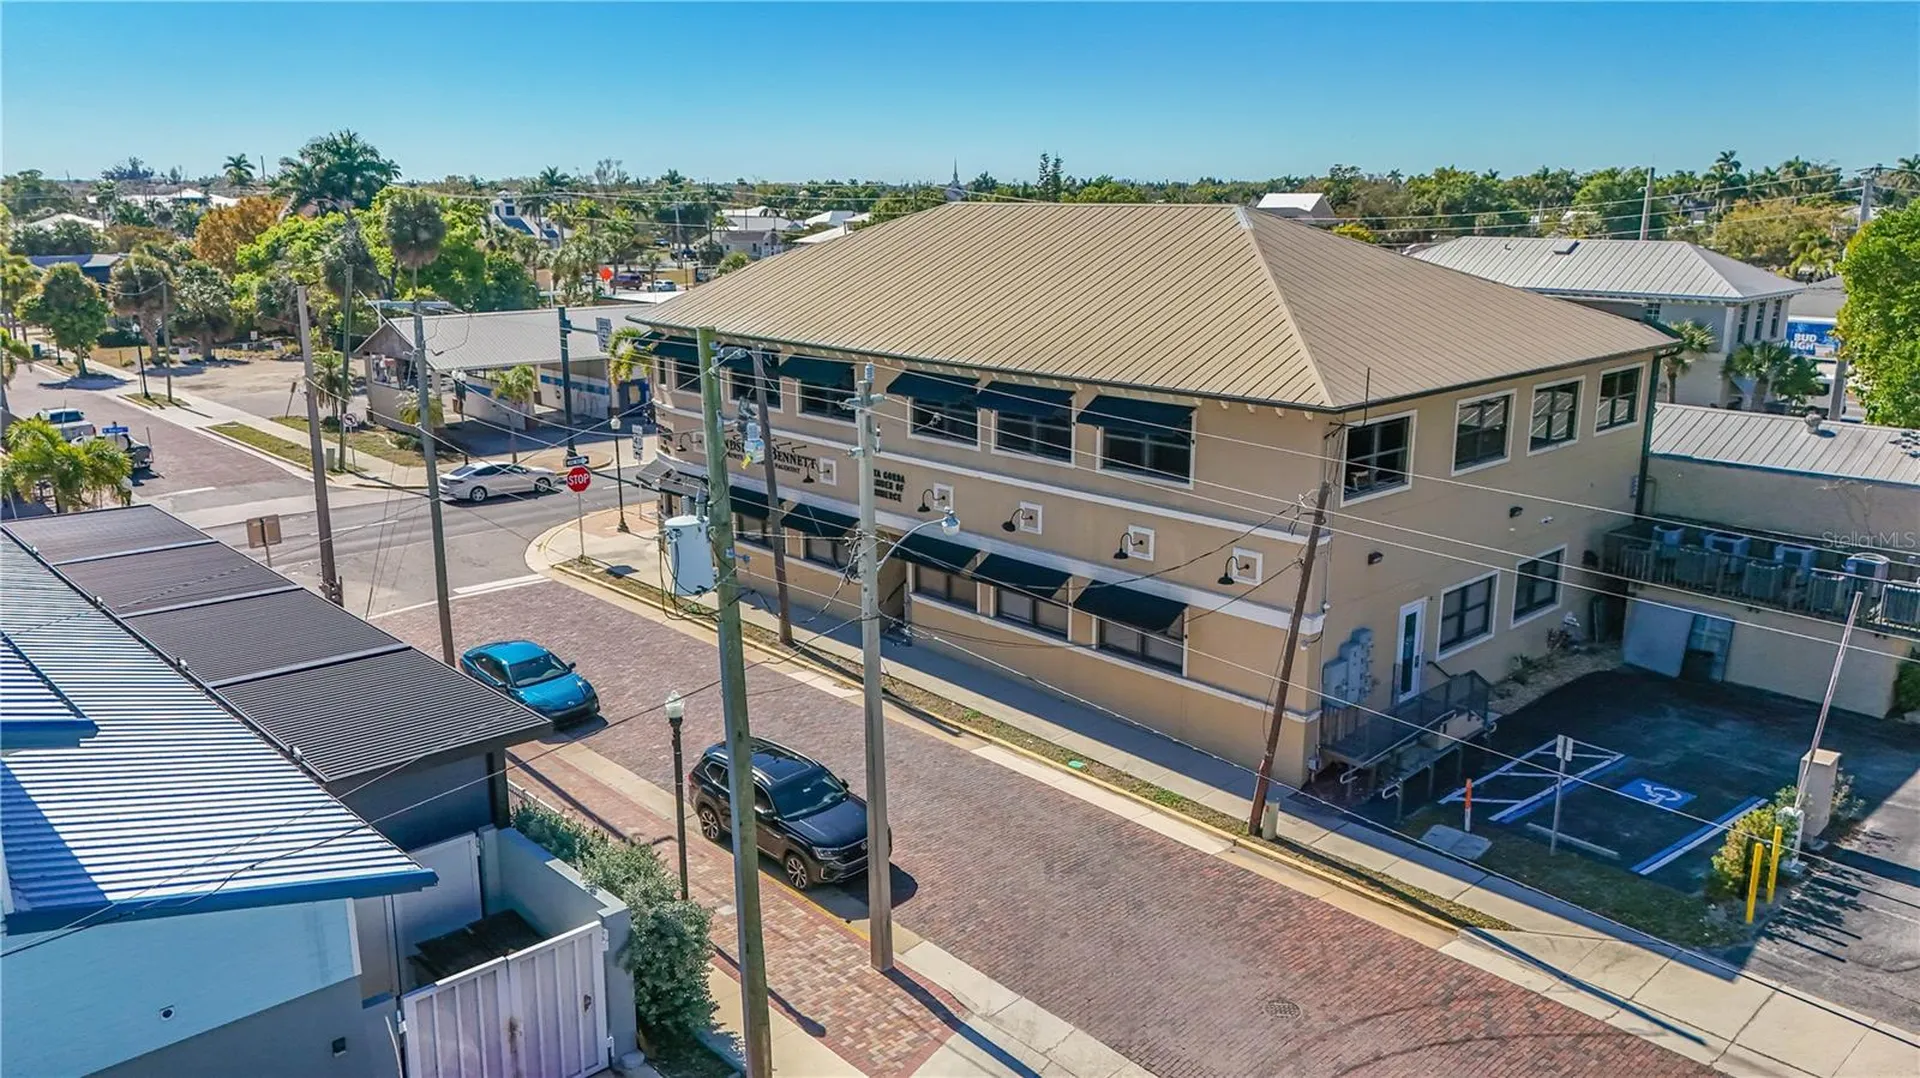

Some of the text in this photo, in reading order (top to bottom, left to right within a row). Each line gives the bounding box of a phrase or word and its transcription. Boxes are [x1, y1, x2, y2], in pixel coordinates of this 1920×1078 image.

[1794, 333, 1817, 342] BUD
[1790, 341, 1814, 350] LIGH
[772, 446, 816, 469] BENNETT
[568, 473, 589, 487] STOP
